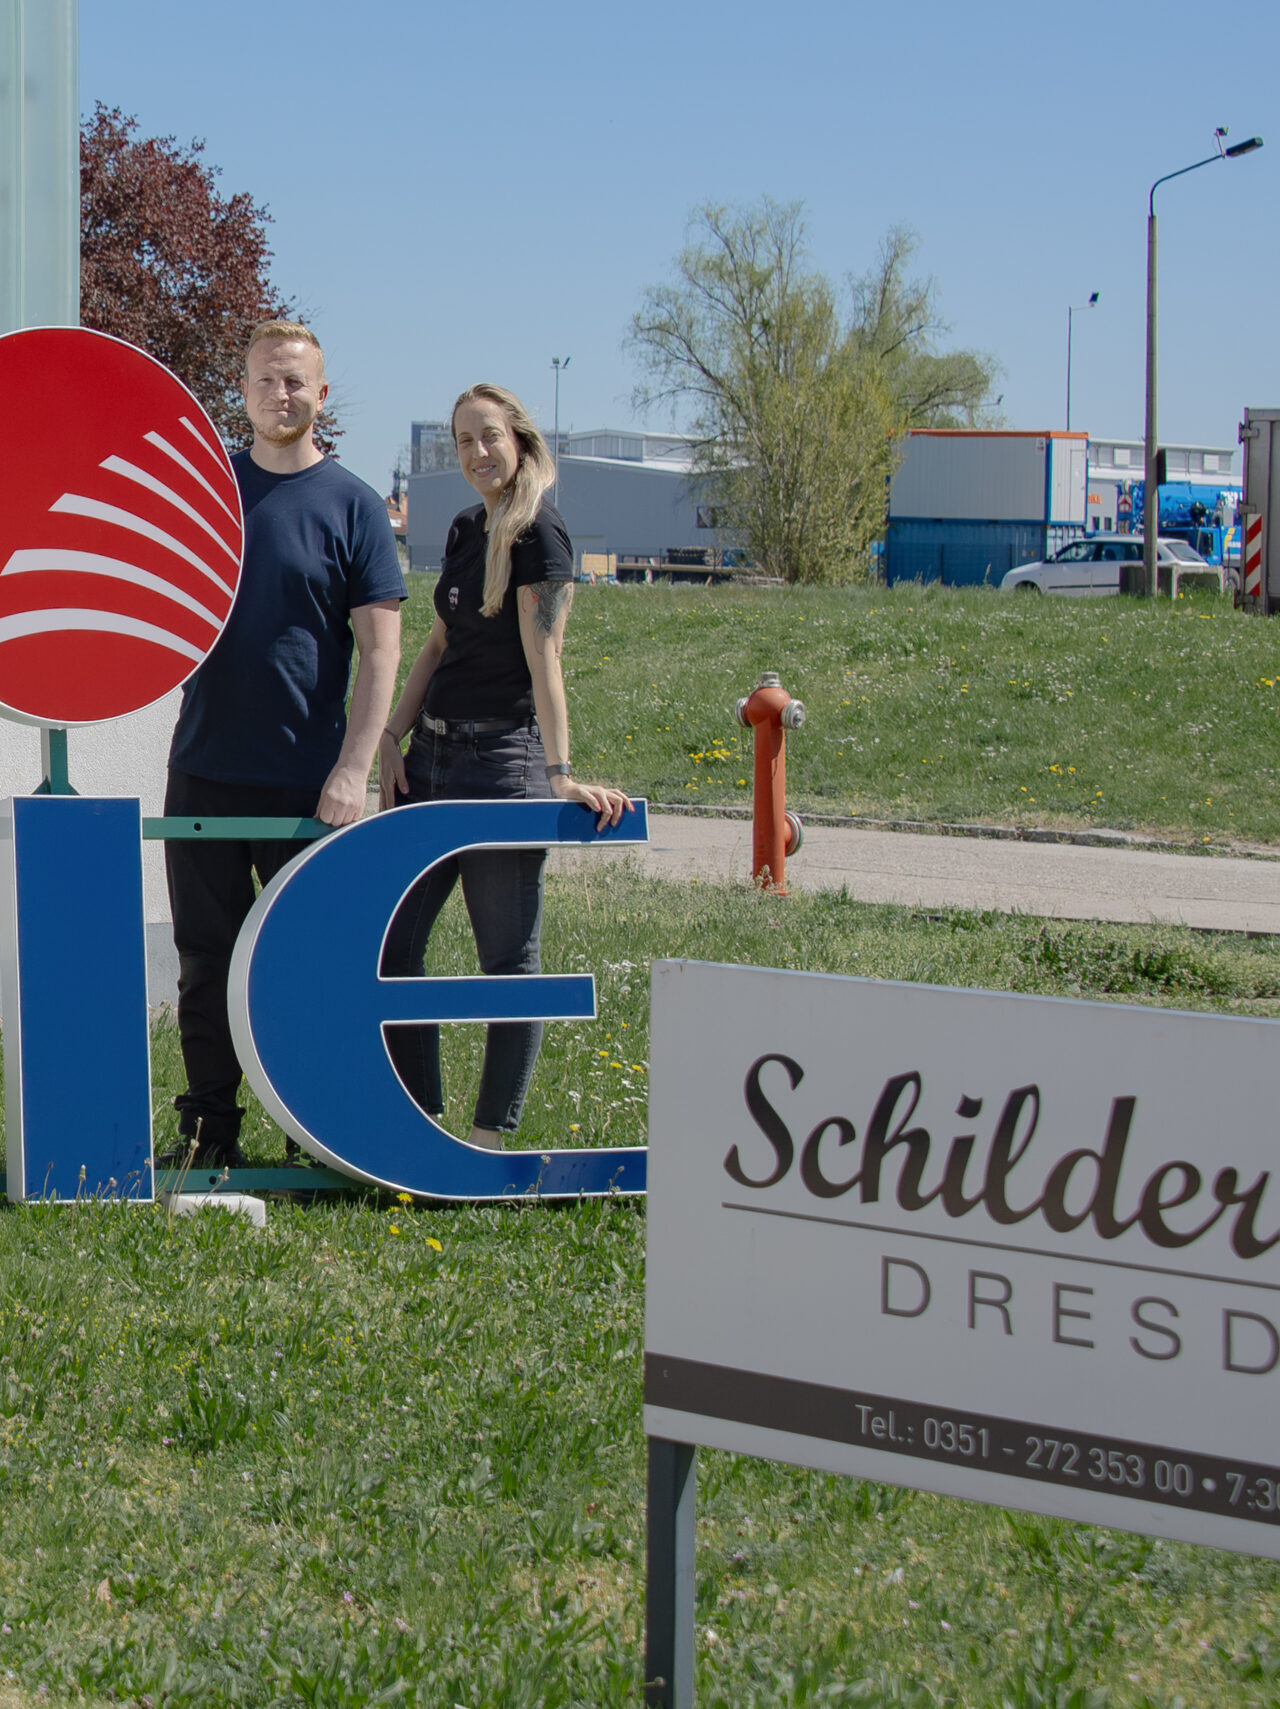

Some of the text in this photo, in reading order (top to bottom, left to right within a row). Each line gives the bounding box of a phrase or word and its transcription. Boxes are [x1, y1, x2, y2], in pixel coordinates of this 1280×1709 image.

[723, 1053, 1280, 1260] Schilder
[881, 1255, 1280, 1375] DRESD
[855, 1403, 915, 1444] Tel.:
[923, 1417, 989, 1459] 0351
[1025, 1436, 1081, 1476] 272
[1088, 1447, 1145, 1488] 353
[1154, 1459, 1194, 1497] 00
[1225, 1471, 1280, 1513] 7:3
